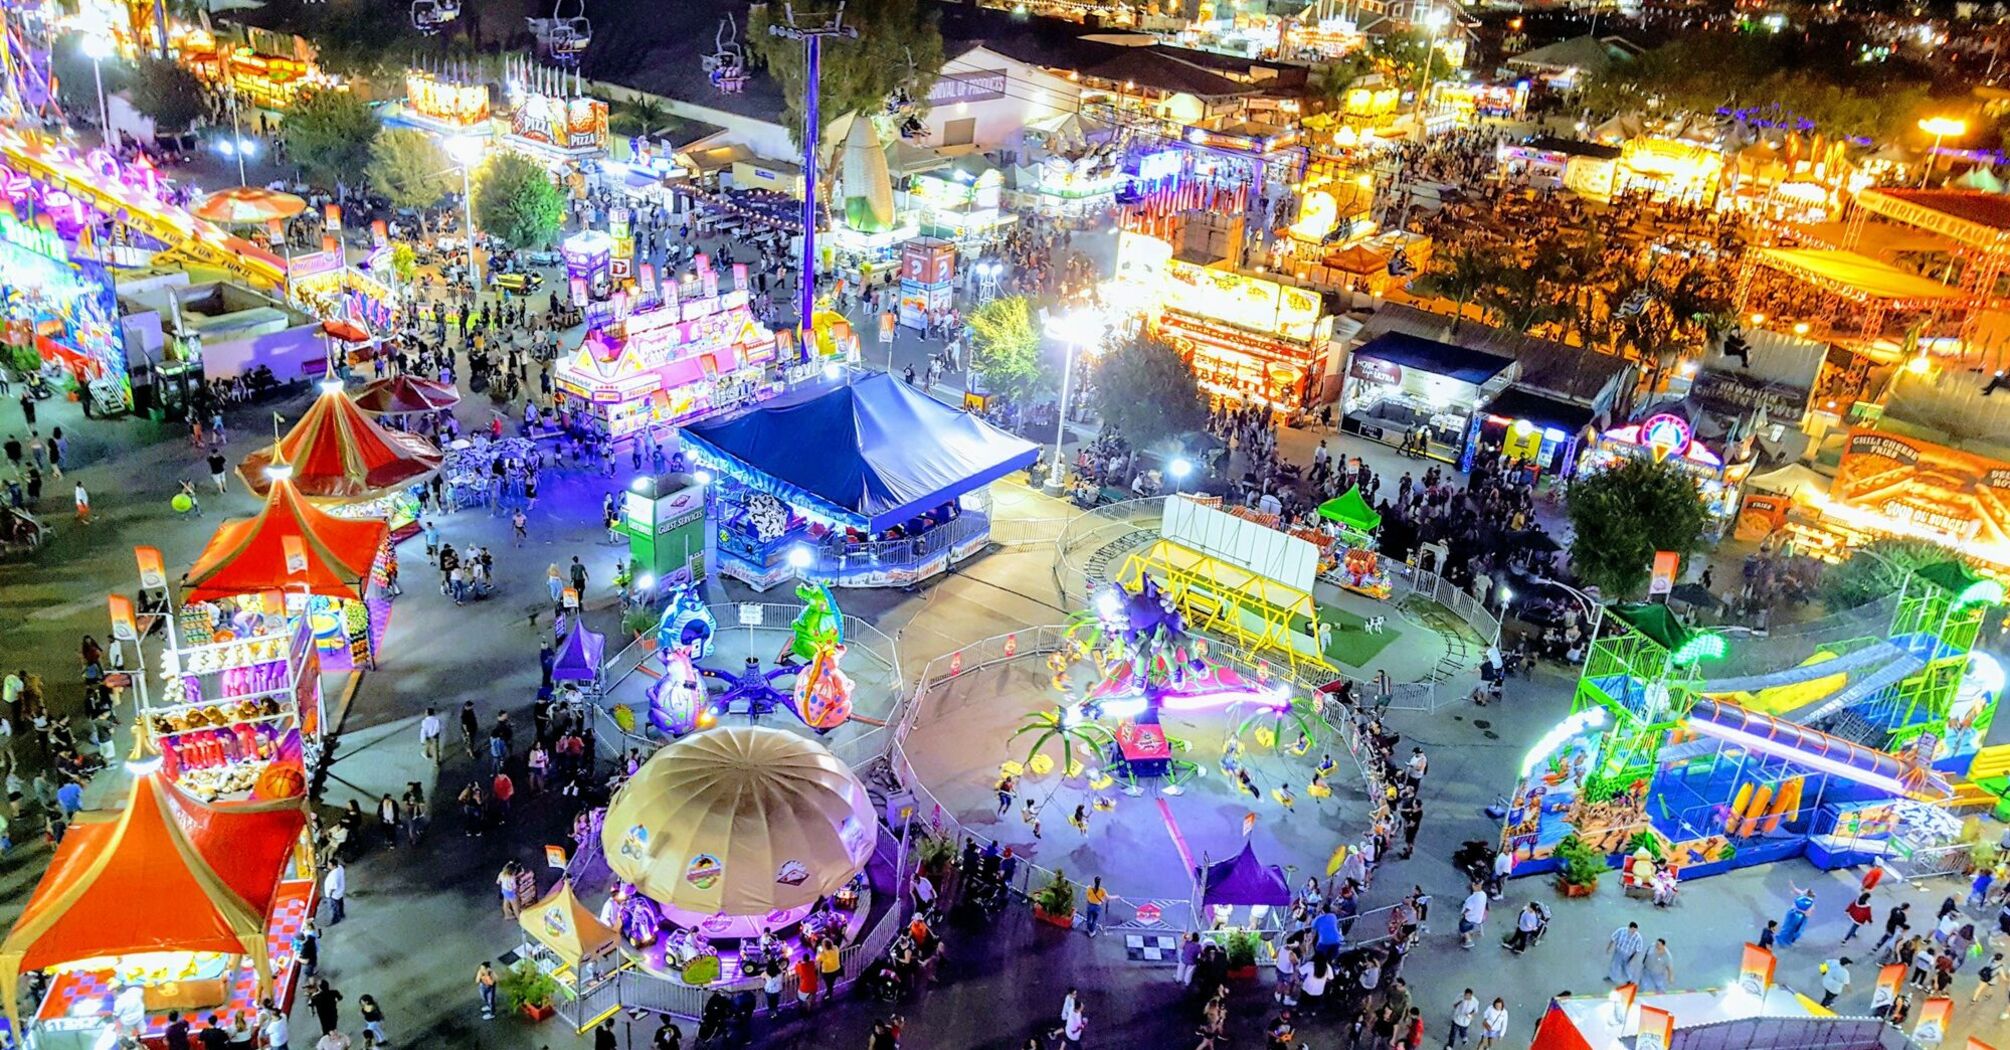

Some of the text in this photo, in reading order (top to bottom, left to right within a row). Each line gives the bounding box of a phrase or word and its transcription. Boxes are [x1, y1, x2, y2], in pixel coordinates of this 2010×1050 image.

[524, 115, 554, 142] PIZZA
[570, 133, 595, 147] PIZZA
[1880, 199, 1992, 243] HERITAGE STAGE
[130, 216, 154, 232] IT'S
[163, 231, 185, 245] FUN
[192, 243, 213, 259] FUN
[1695, 384, 1750, 407] CHICKEN
[1719, 383, 1779, 403] HAWAIIAN
[1852, 436, 1920, 462] CHILI CHEESE
[1869, 445, 1899, 460] FRIES
[1752, 501, 1773, 511] FRIES
[1885, 500, 1914, 519] GOOD
[658, 520, 677, 534] GUEST
[677, 511, 703, 527] SERVICES
